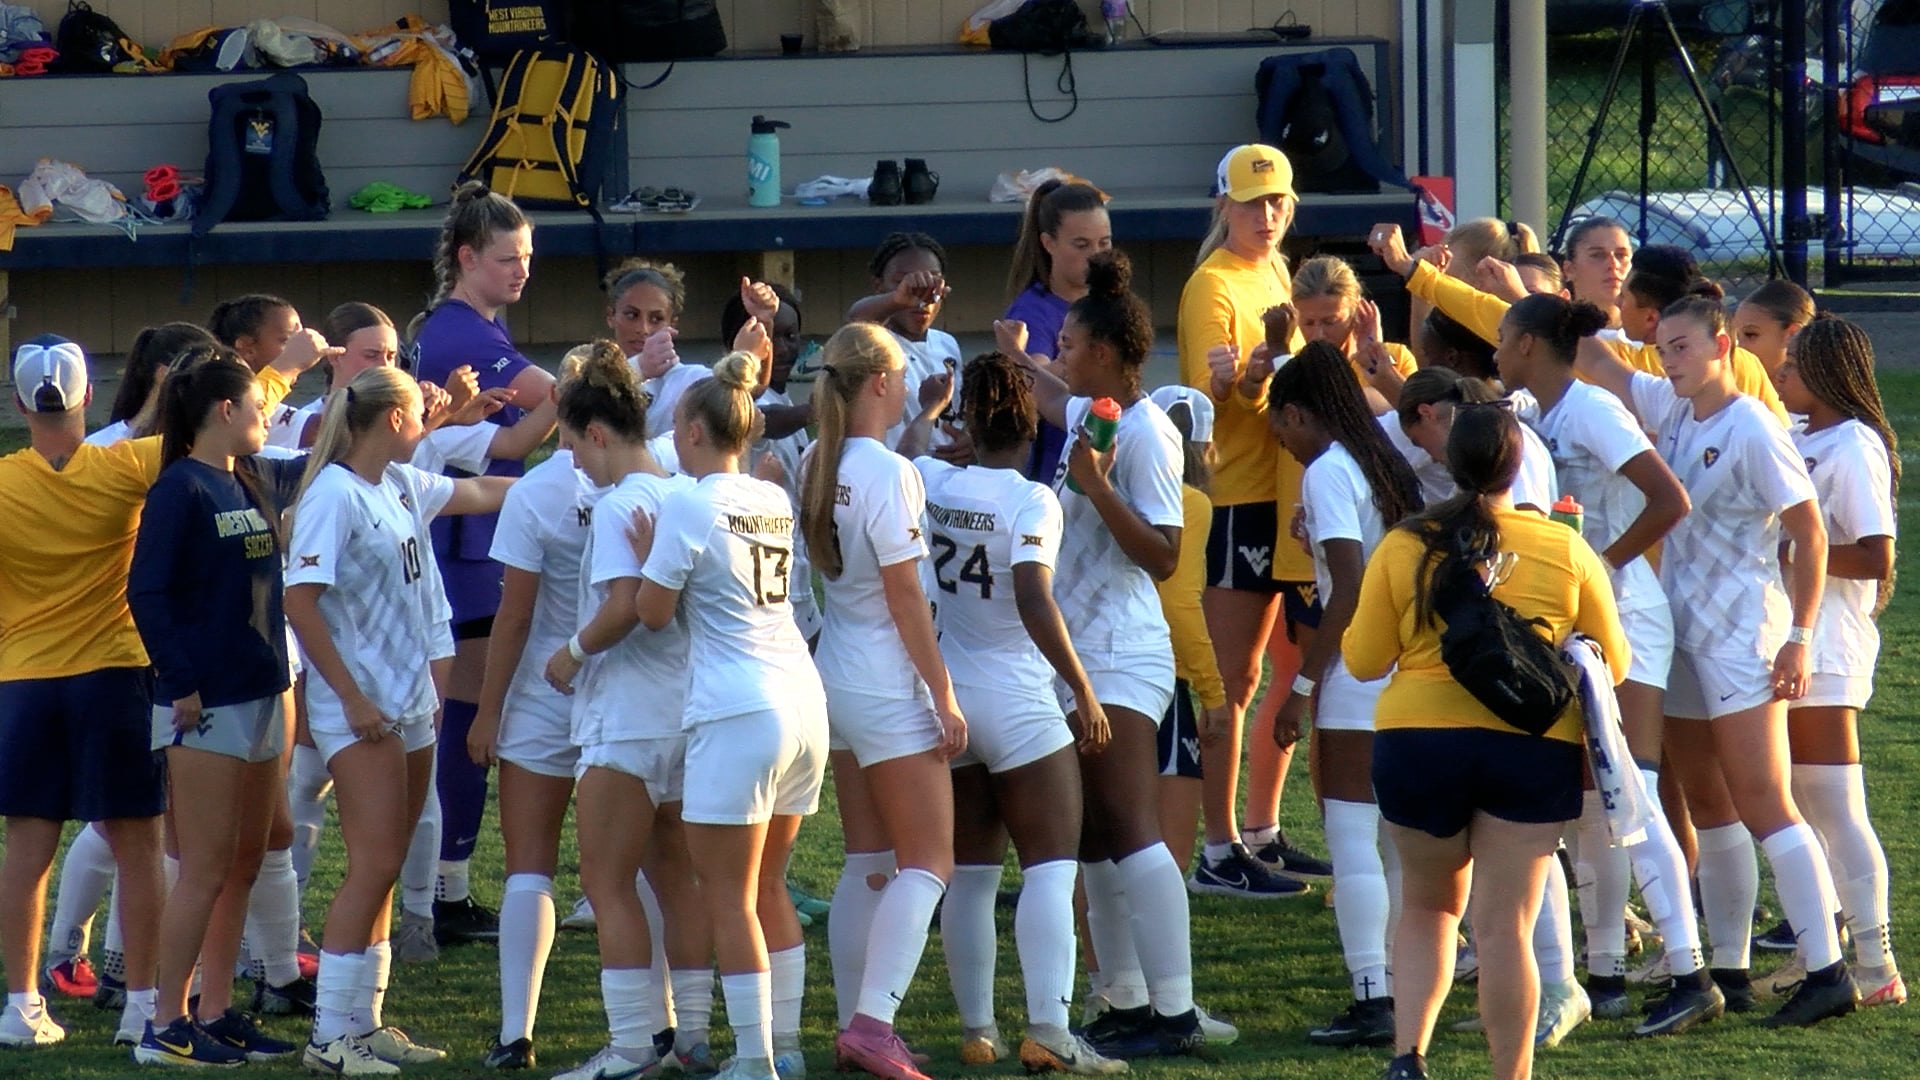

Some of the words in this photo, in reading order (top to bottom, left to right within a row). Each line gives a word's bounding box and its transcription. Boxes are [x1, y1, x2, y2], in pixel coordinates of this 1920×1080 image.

[488, 8, 508, 21] WEST
[510, 6, 544, 19] VIRGINIA
[488, 18, 546, 34] MOUNTAINEERS
[401, 536, 421, 585] 10
[749, 544, 790, 606] 13
[931, 532, 994, 600] 24
